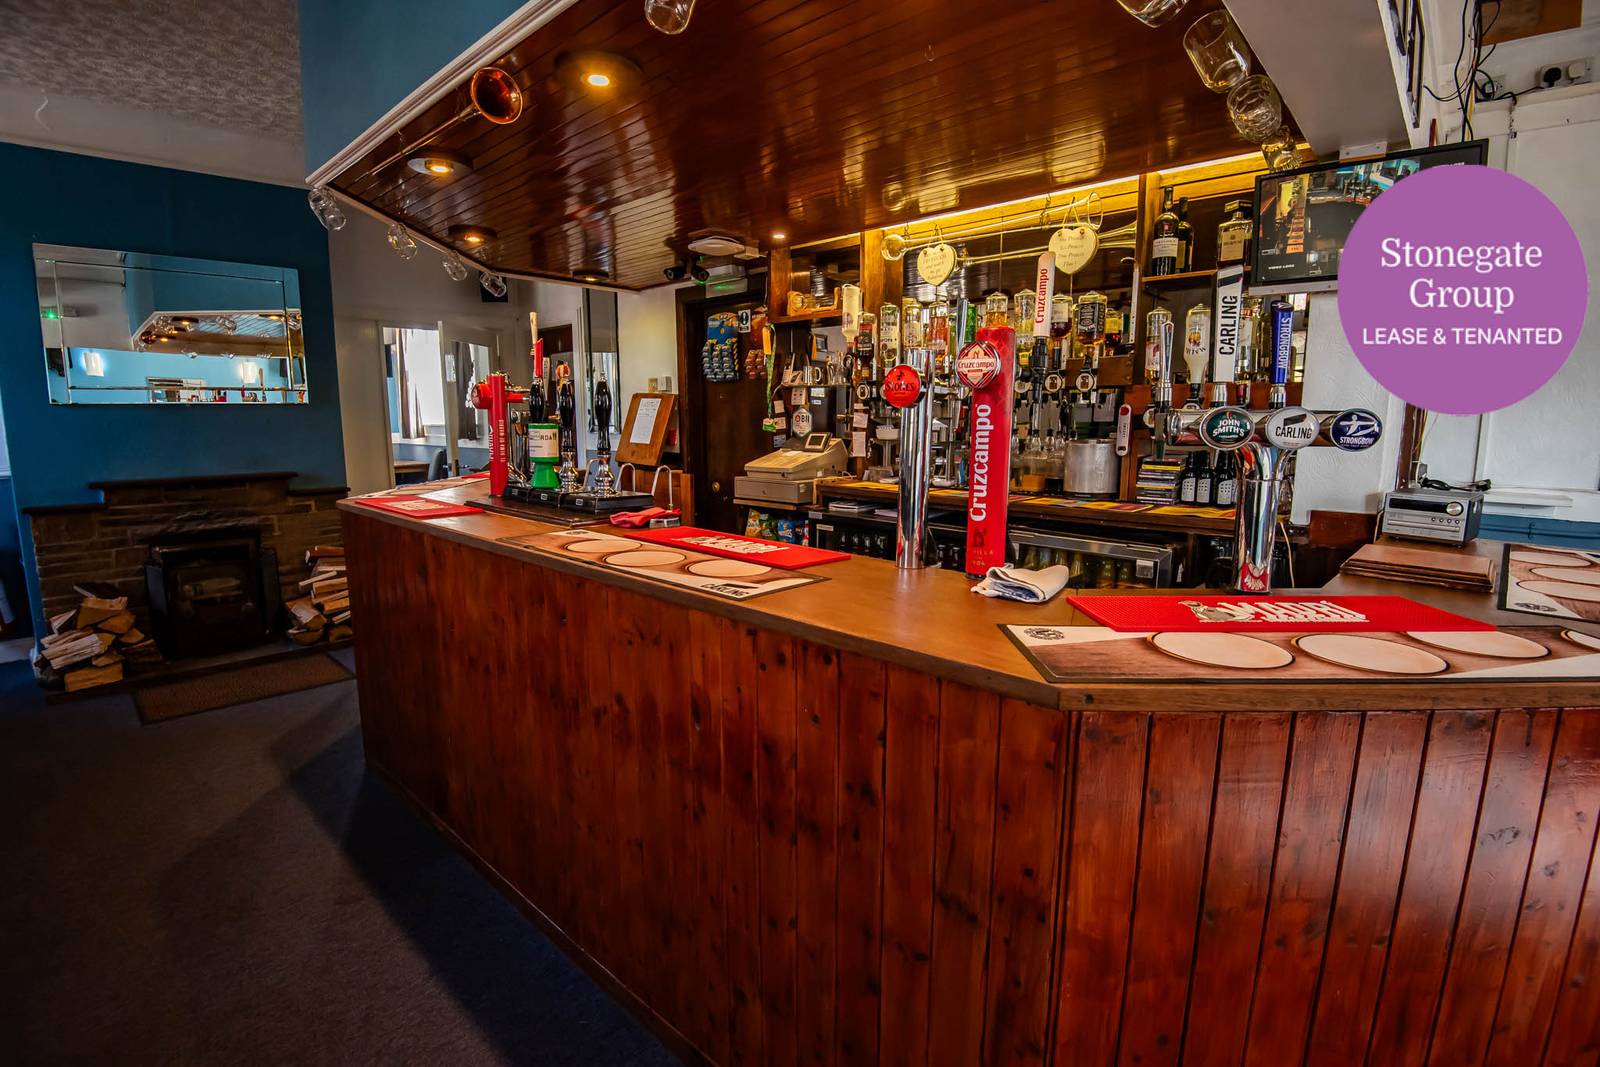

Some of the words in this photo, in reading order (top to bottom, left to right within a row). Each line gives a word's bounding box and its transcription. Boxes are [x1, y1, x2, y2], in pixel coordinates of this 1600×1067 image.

[1035, 268, 1049, 324] Cruzcampo
[1219, 295, 1238, 356] CARLING
[1278, 316, 1291, 369] STRONGBOW
[1217, 419, 1241, 428] JOHN
[1212, 425, 1245, 437] SMITH'S
[1275, 426, 1313, 439] CARLING
[1340, 436, 1375, 445] STRONGBOW
[970, 404, 994, 522] Cruzcampo
[700, 583, 750, 597] CARLING
